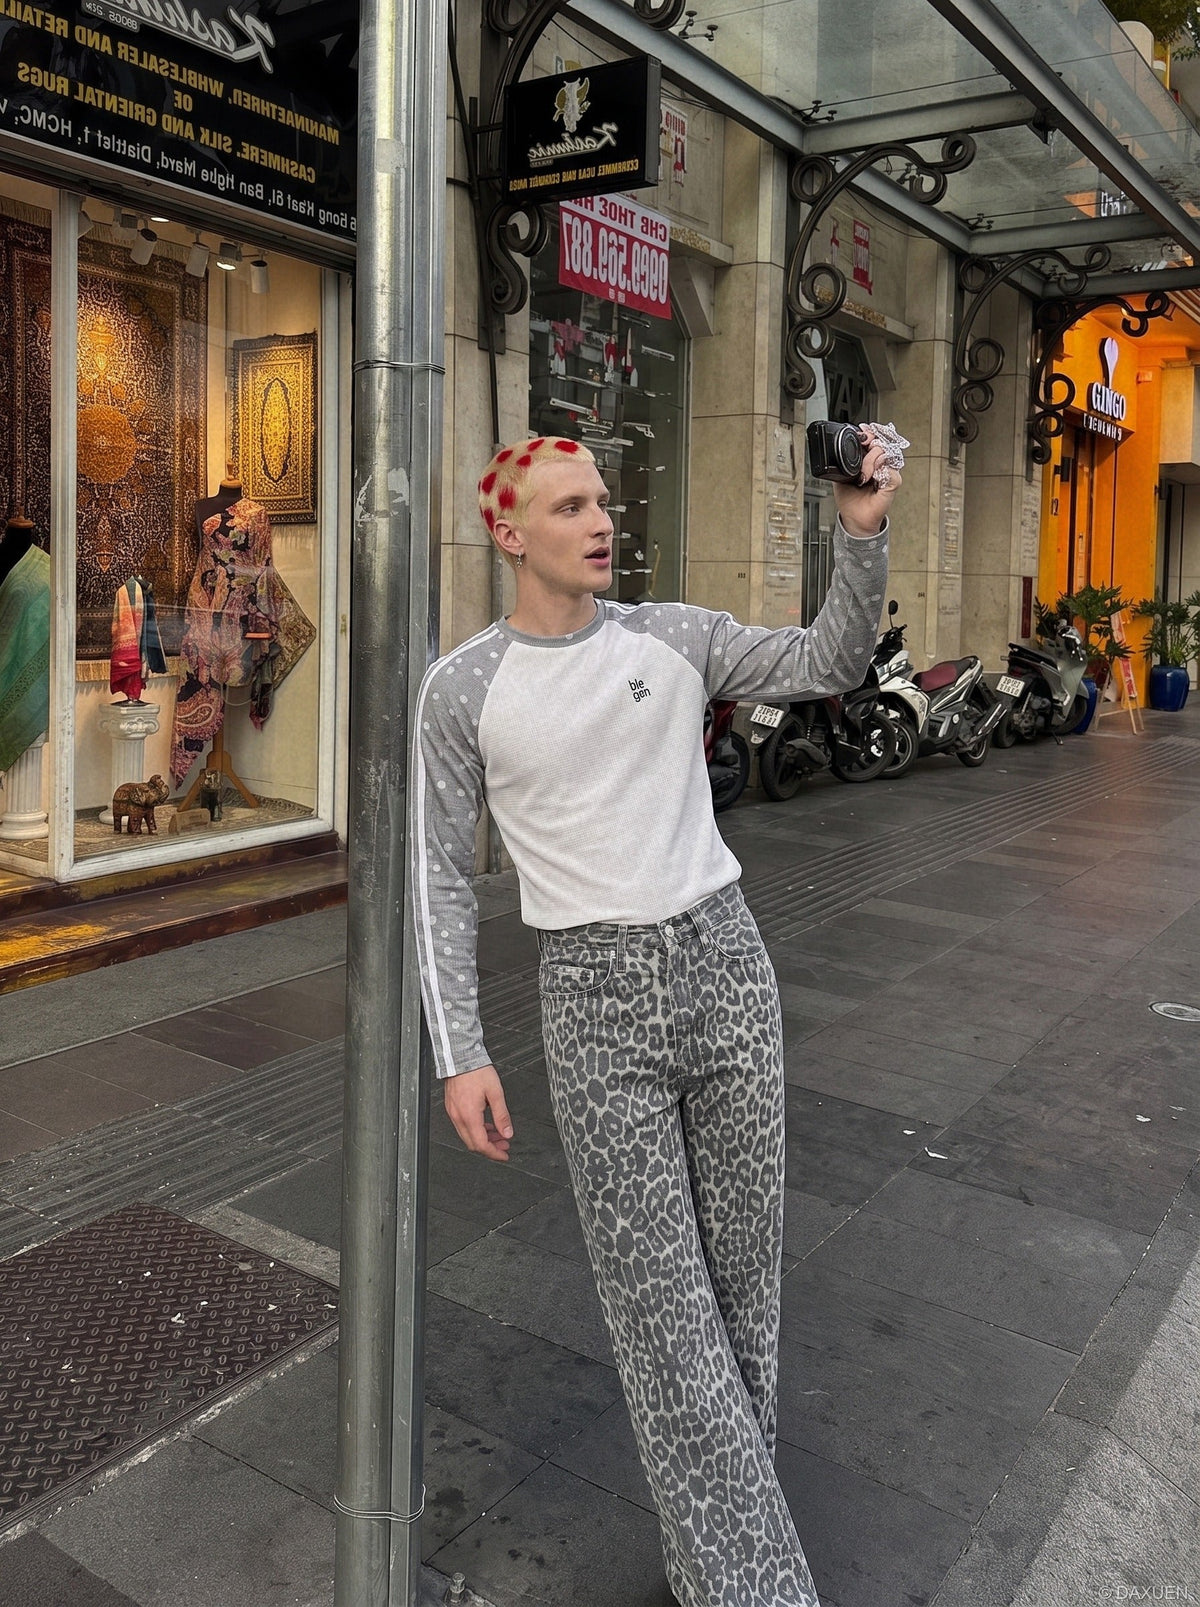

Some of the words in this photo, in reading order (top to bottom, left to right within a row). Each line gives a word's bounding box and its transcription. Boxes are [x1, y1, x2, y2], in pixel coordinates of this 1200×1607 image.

[1092, 382, 1126, 421] GINGO
[628, 679, 645, 691] ble
[633, 688, 651, 702] gen
